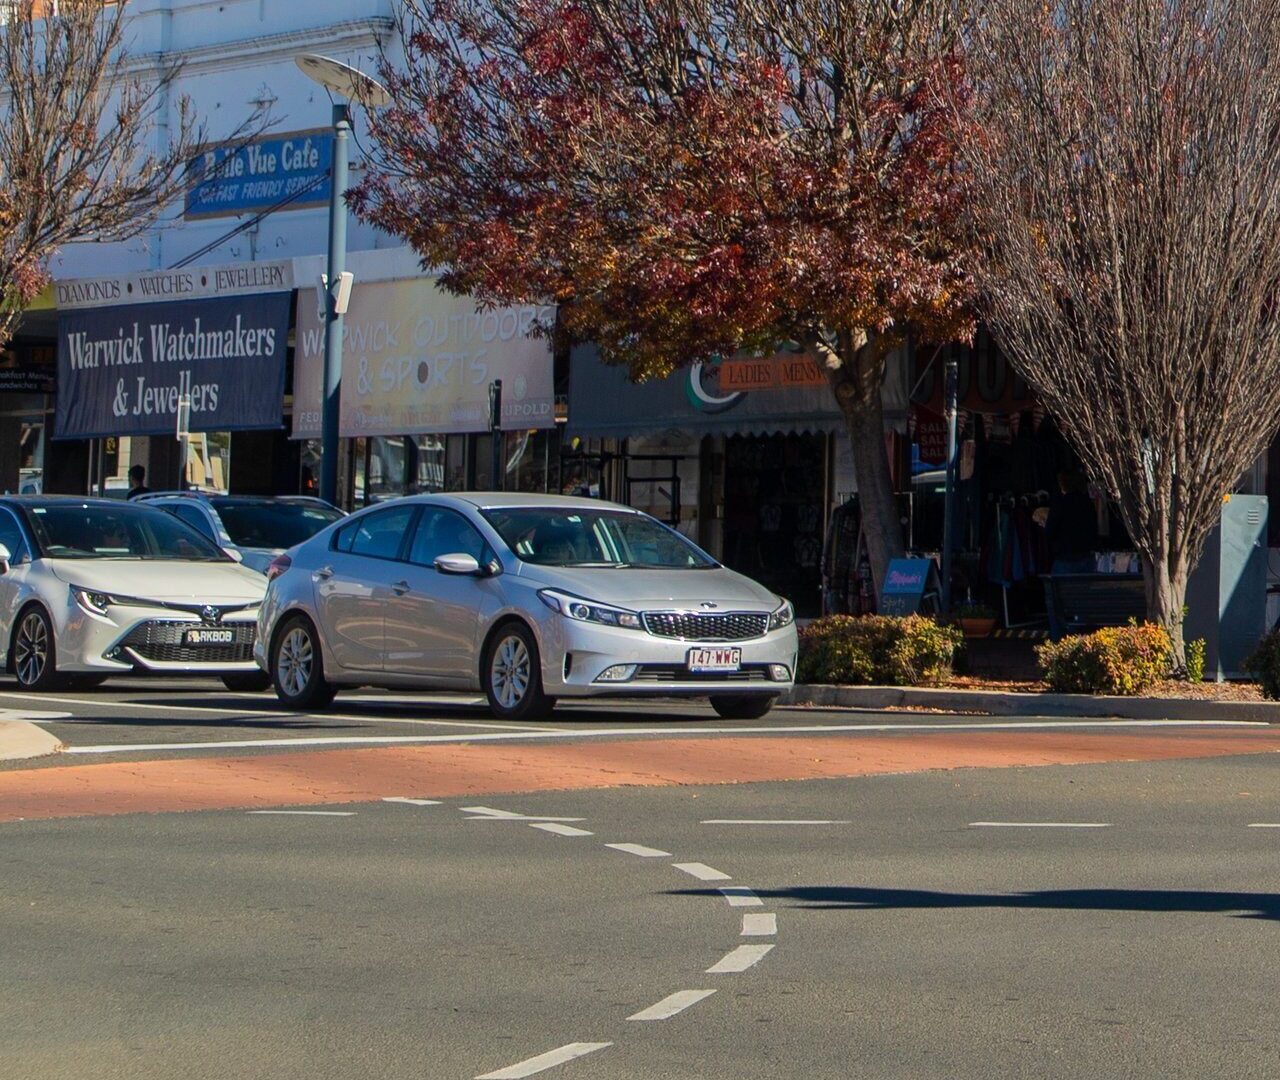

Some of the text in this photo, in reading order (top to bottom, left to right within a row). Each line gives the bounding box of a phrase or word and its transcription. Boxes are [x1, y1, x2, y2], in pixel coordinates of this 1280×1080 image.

[247, 144, 278, 176] Vue
[241, 179, 285, 200] FRIENDLY
[58, 266, 287, 304] DIAMONDS WATCHES JEWELLERY
[68, 314, 276, 371] Warwick Watchmakers
[414, 306, 555, 350] OUTDOORS
[357, 348, 490, 395] & SPORTS
[729, 364, 771, 384] LADIES
[113, 370, 220, 417] & Jewellers
